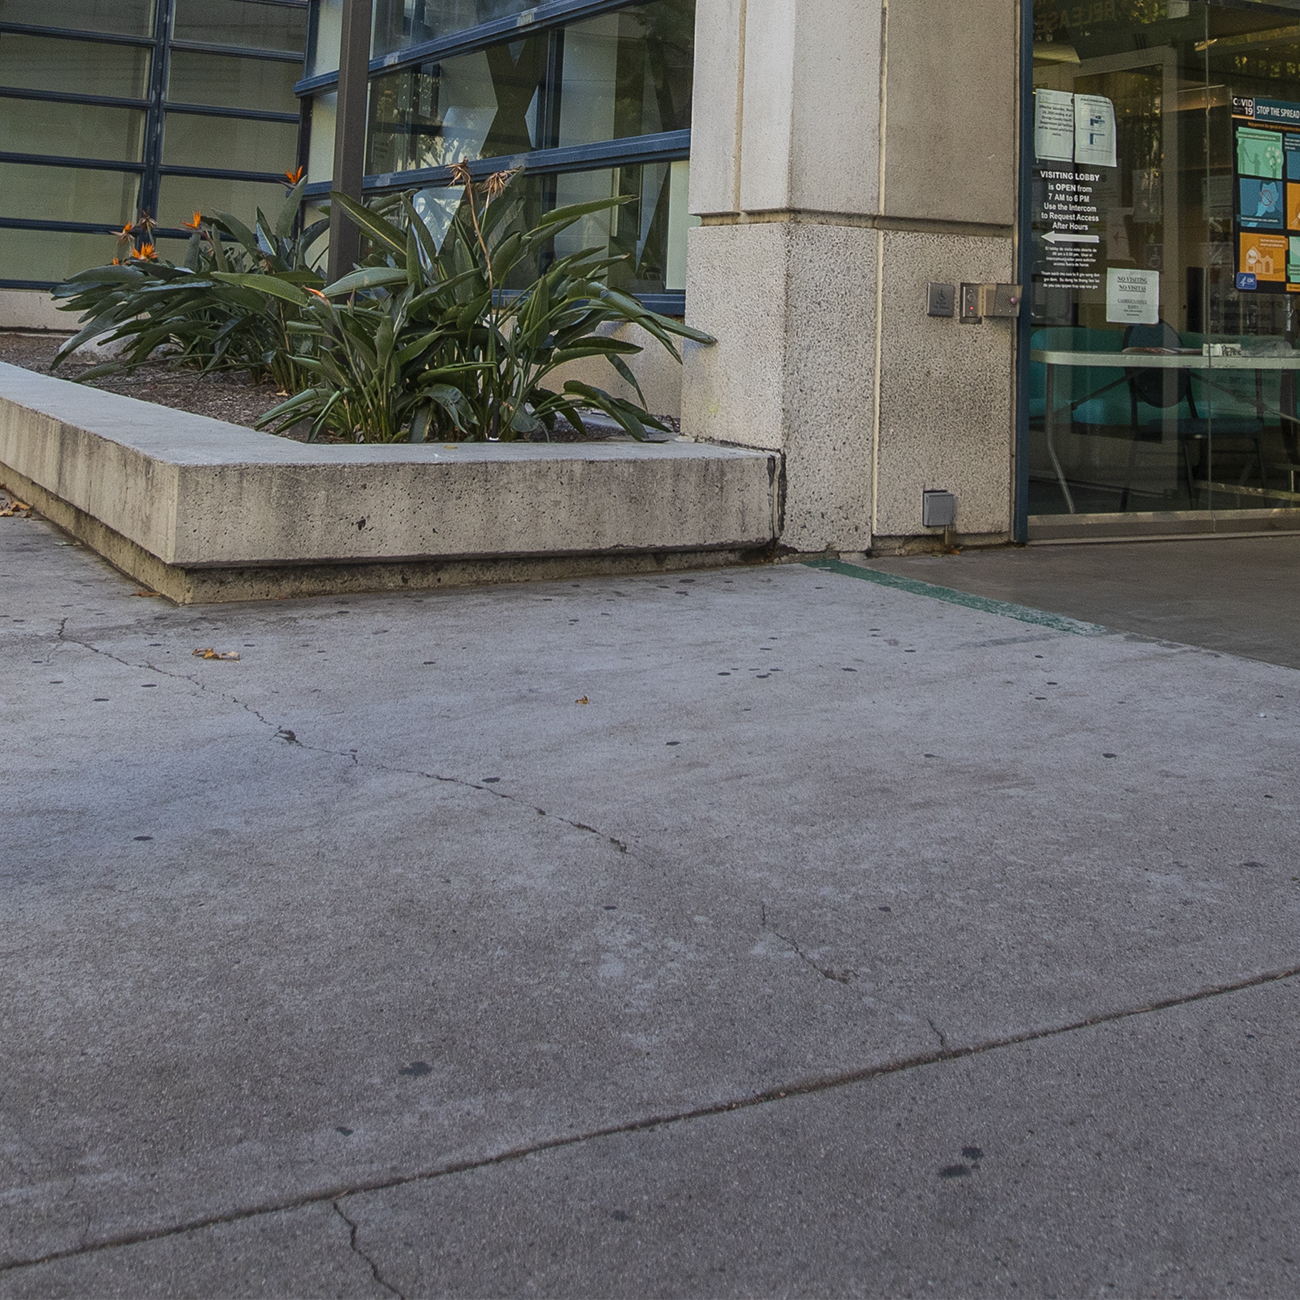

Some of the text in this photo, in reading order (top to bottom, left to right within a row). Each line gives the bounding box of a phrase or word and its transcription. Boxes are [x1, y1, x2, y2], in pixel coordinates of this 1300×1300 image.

[1257, 106, 1269, 115] STOP
[1271, 108, 1280, 116] THE
[1281, 109, 1299, 119] SPREAD
[1040, 171, 1099, 181] VISITING LOBBY
[1044, 202, 1056, 210] Use
[1069, 204, 1096, 212] Intercom
[1049, 212, 1075, 221] Request
[1077, 214, 1099, 222] Access
